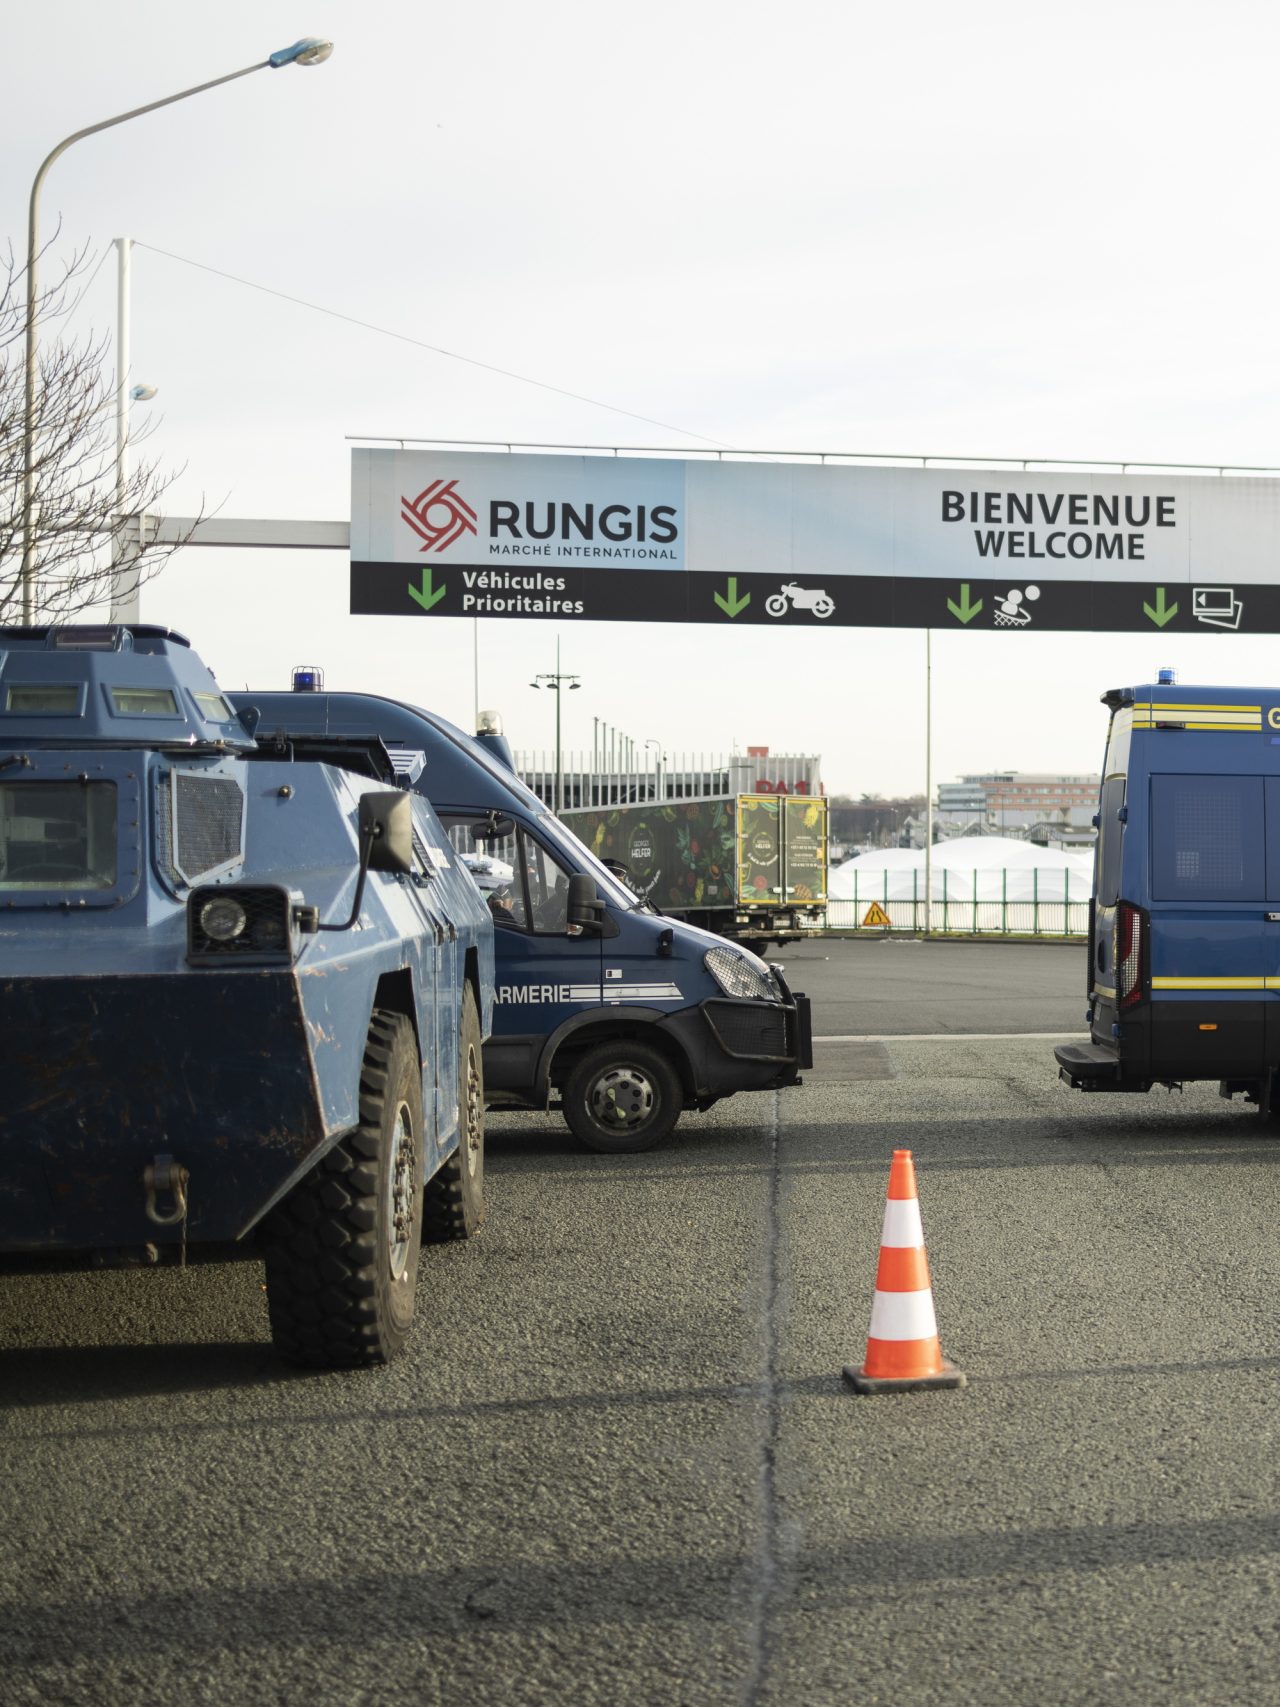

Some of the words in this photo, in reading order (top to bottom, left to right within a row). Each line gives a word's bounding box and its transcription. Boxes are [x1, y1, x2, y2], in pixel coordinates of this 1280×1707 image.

[941, 490, 1176, 527] BIENVENUE
[490, 500, 678, 543] RUNGIS
[490, 543, 551, 556] MARCHÉ
[557, 546, 677, 560] INTERNATIONAL
[974, 530, 1145, 560] WELCOME
[462, 571, 566, 591] Véhicules
[463, 594, 584, 614] Prioritaires
